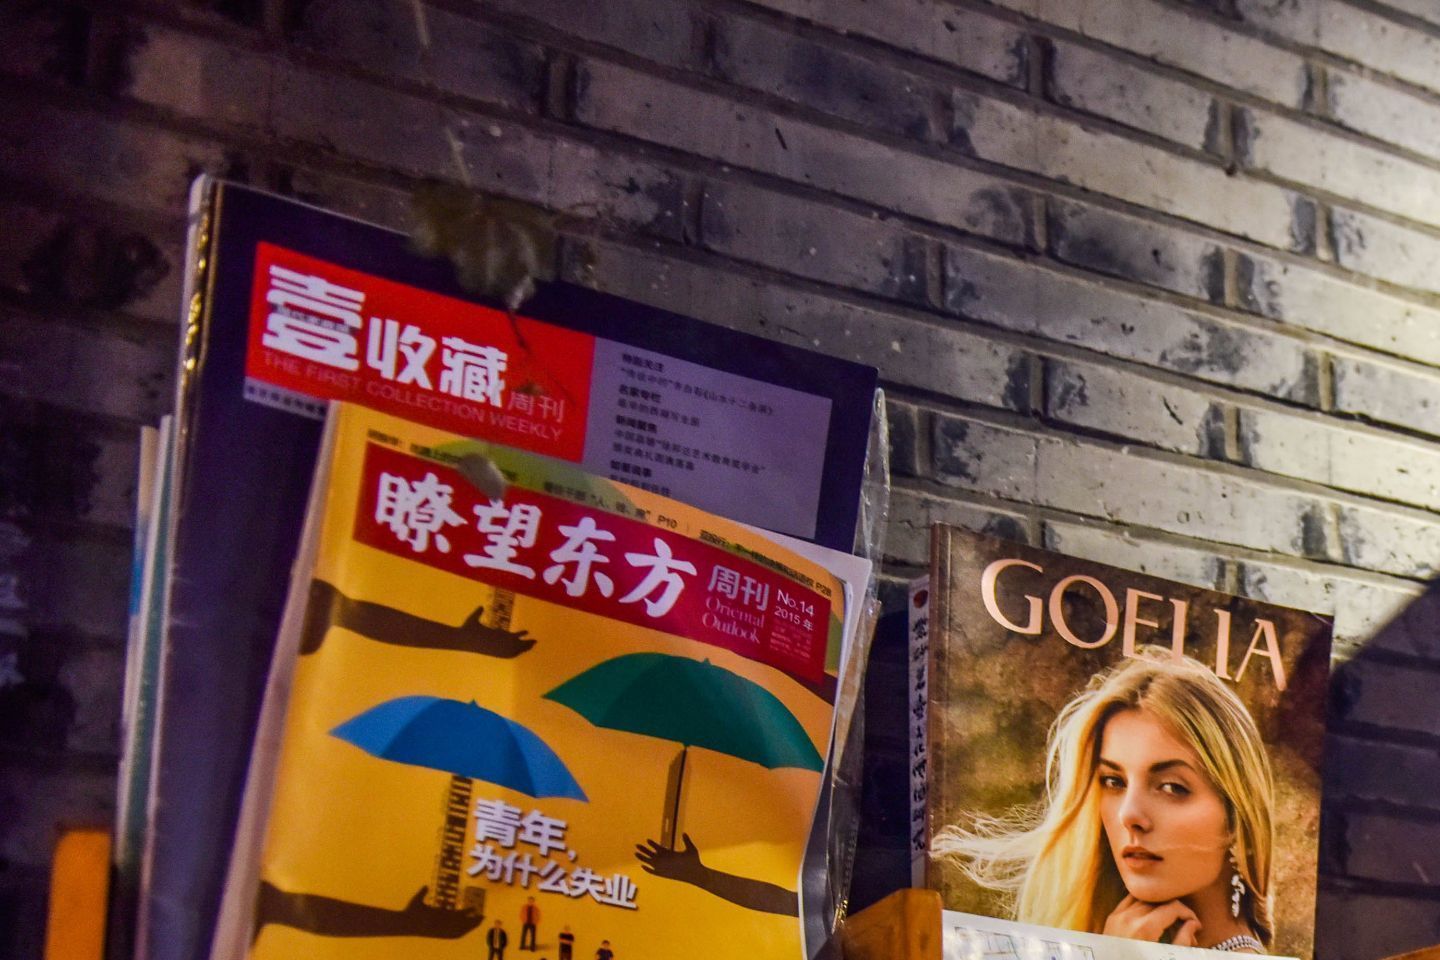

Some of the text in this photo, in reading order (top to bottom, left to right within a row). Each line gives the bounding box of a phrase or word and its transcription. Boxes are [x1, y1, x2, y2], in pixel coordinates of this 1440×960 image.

[262, 264, 507, 407] 壹收藏
[263, 349, 298, 377] THE
[305, 362, 360, 392] FIRST
[366, 379, 485, 423] COLLECTION
[489, 411, 563, 441] WEEKLY
[375, 471, 698, 618] 瞭望东方
[707, 564, 770, 612] 周刊
[702, 612, 761, 645] Outlook
[705, 596, 766, 629] Oriental
[774, 606, 801, 625] 2015
[776, 589, 815, 618] No.14
[467, 843, 639, 911] 为什么失业
